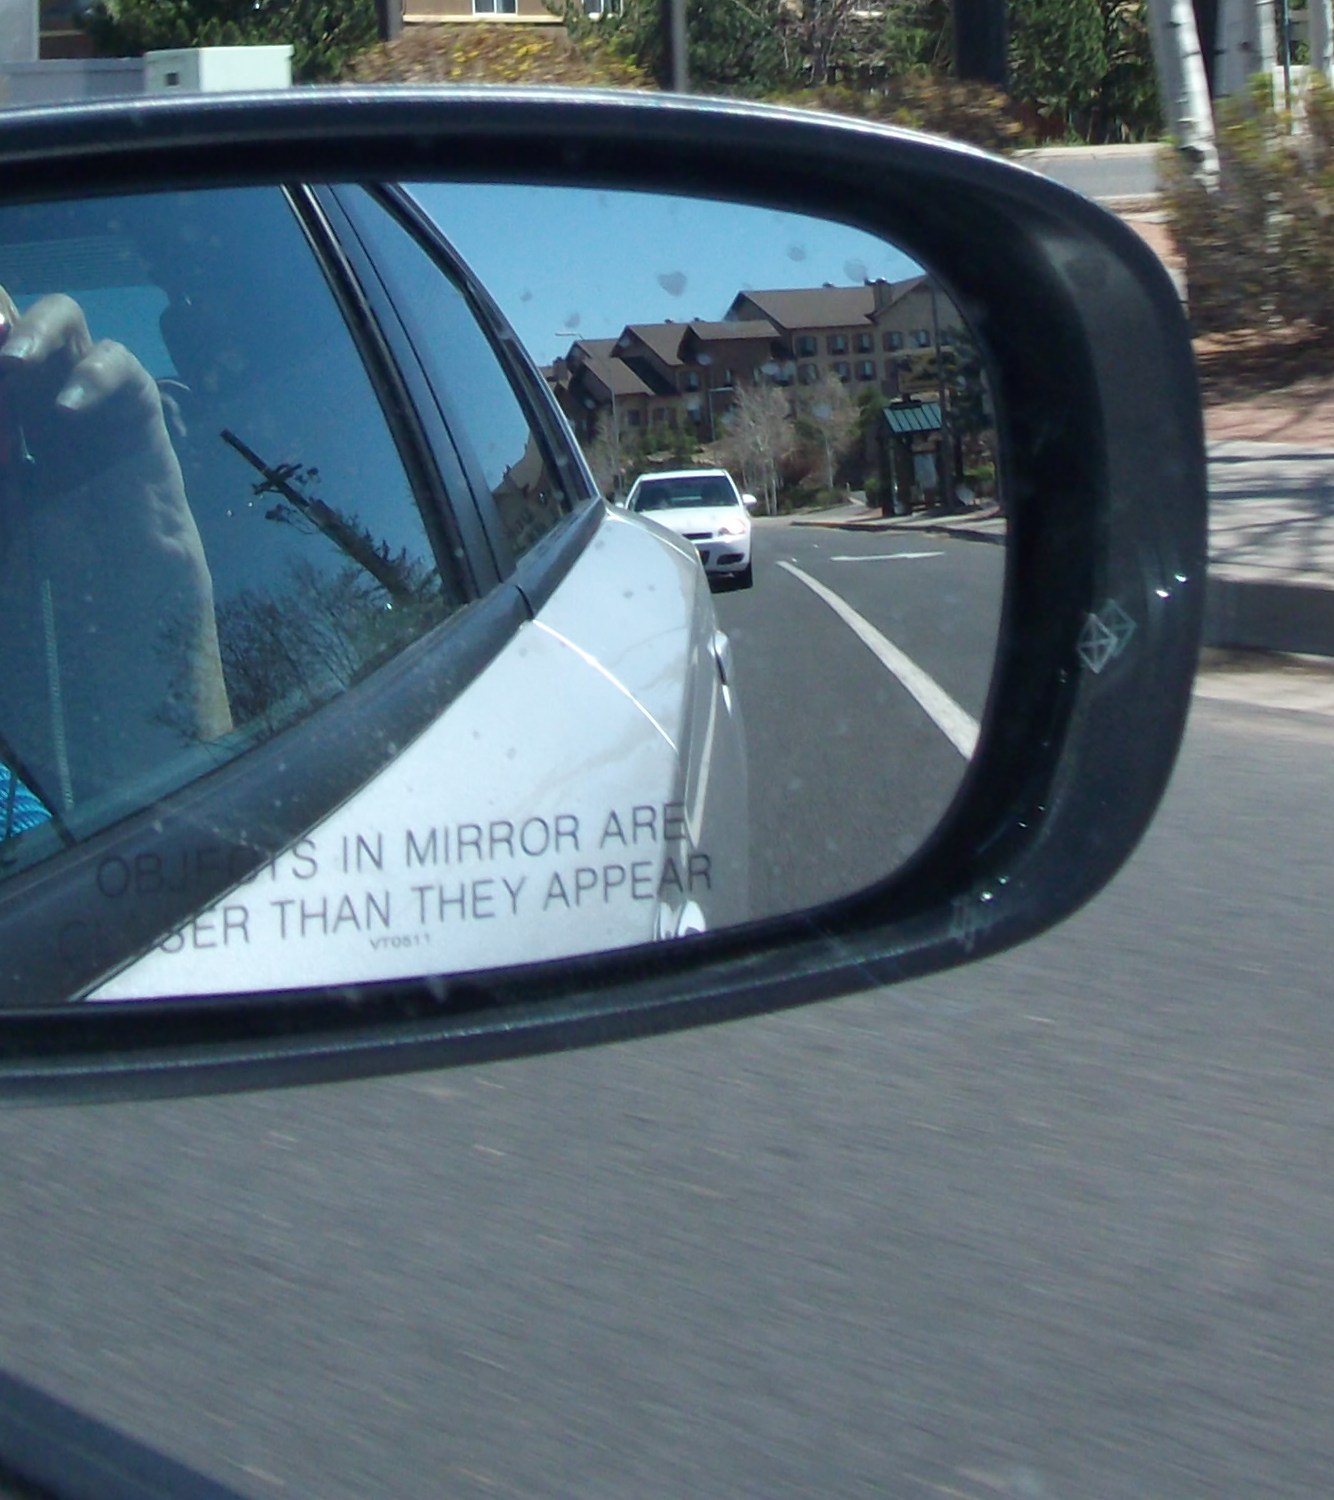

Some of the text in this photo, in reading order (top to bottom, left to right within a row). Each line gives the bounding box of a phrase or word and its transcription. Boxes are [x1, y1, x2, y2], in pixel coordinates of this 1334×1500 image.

[343, 832, 384, 873] IN
[405, 813, 580, 868] MIRROR
[599, 802, 687, 850] ARE
[269, 889, 391, 939] THAN
[410, 876, 527, 925] THEY
[542, 852, 713, 912] APPEAR
